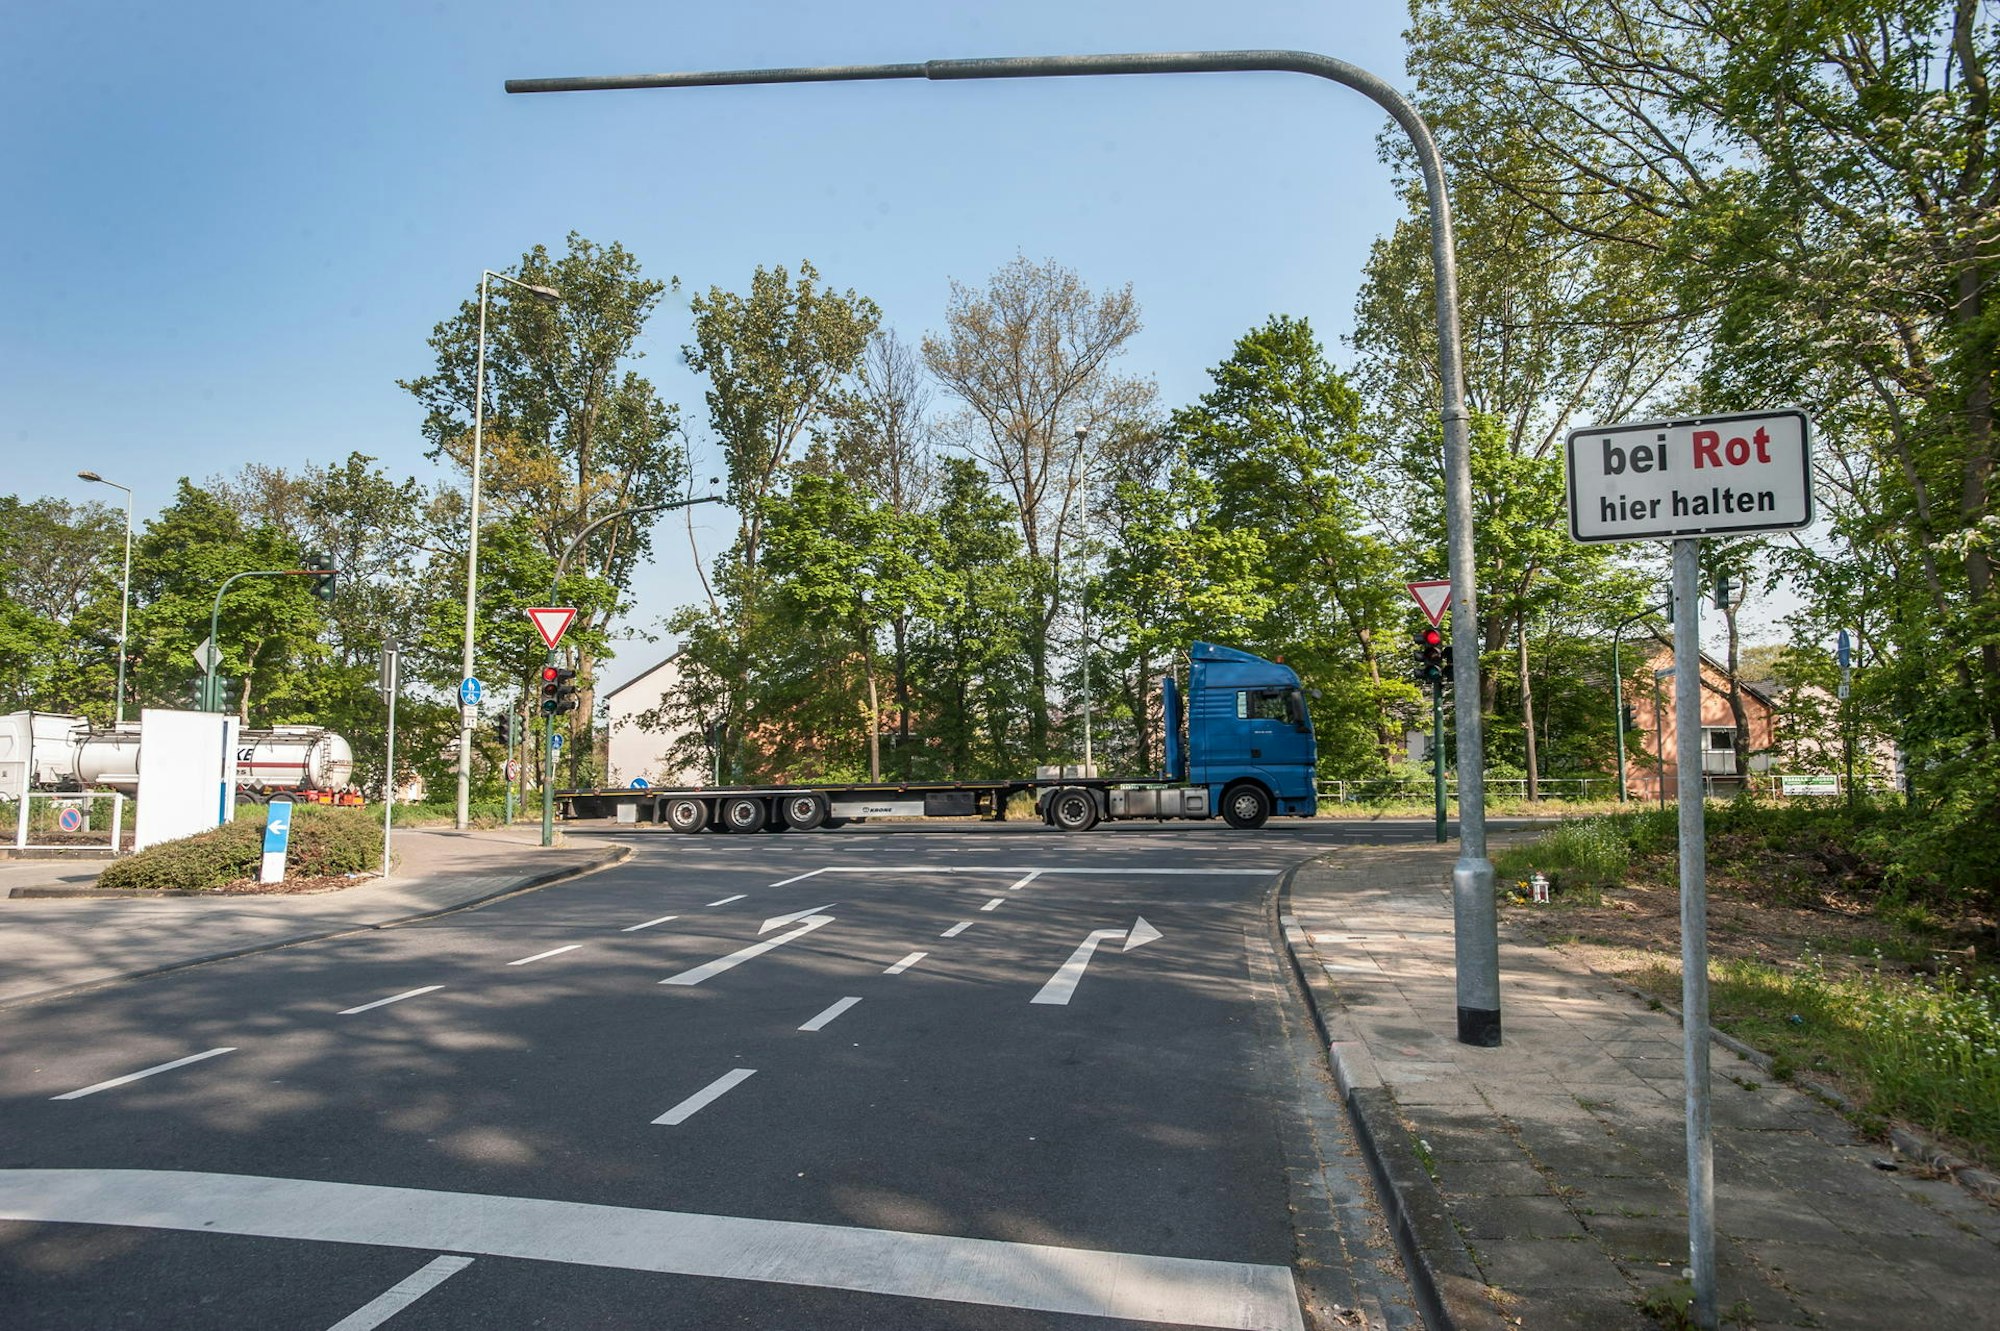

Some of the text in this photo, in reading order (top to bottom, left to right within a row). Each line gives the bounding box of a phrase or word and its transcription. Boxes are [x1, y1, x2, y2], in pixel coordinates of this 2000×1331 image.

[1602, 426, 1771, 475] bei Rot
[1600, 487, 1775, 522] hier halten
